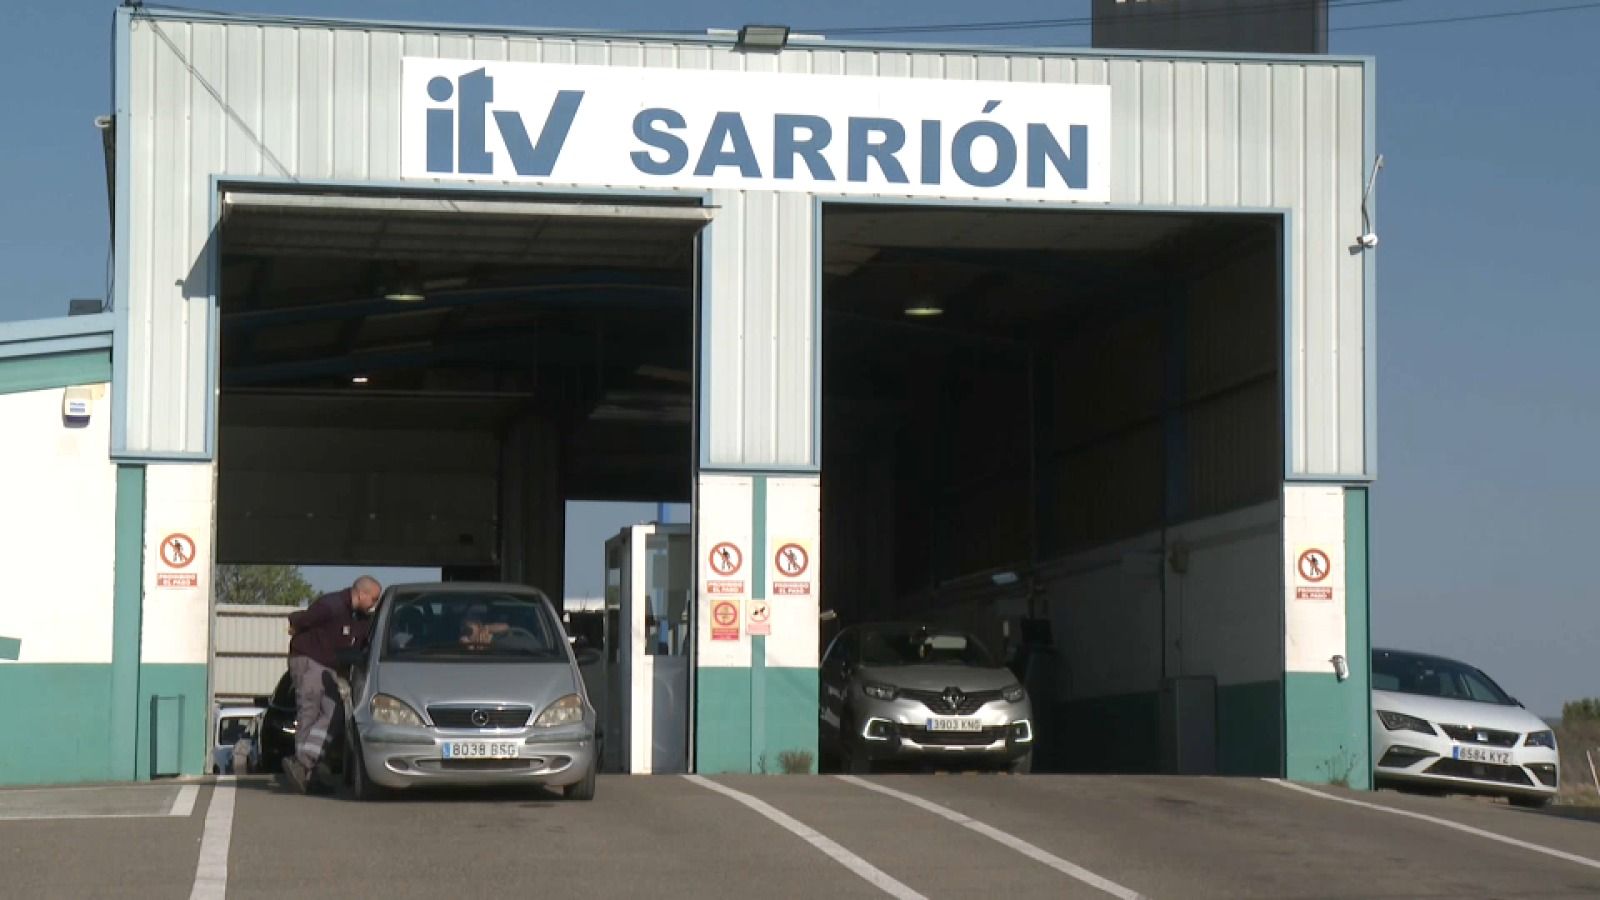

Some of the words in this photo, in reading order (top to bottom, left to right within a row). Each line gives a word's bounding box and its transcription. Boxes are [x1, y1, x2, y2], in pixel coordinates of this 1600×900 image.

[629, 99, 1089, 190] SARRIÓN
[452, 743, 486, 755] 8038
[1490, 751, 1509, 764] KYZ
